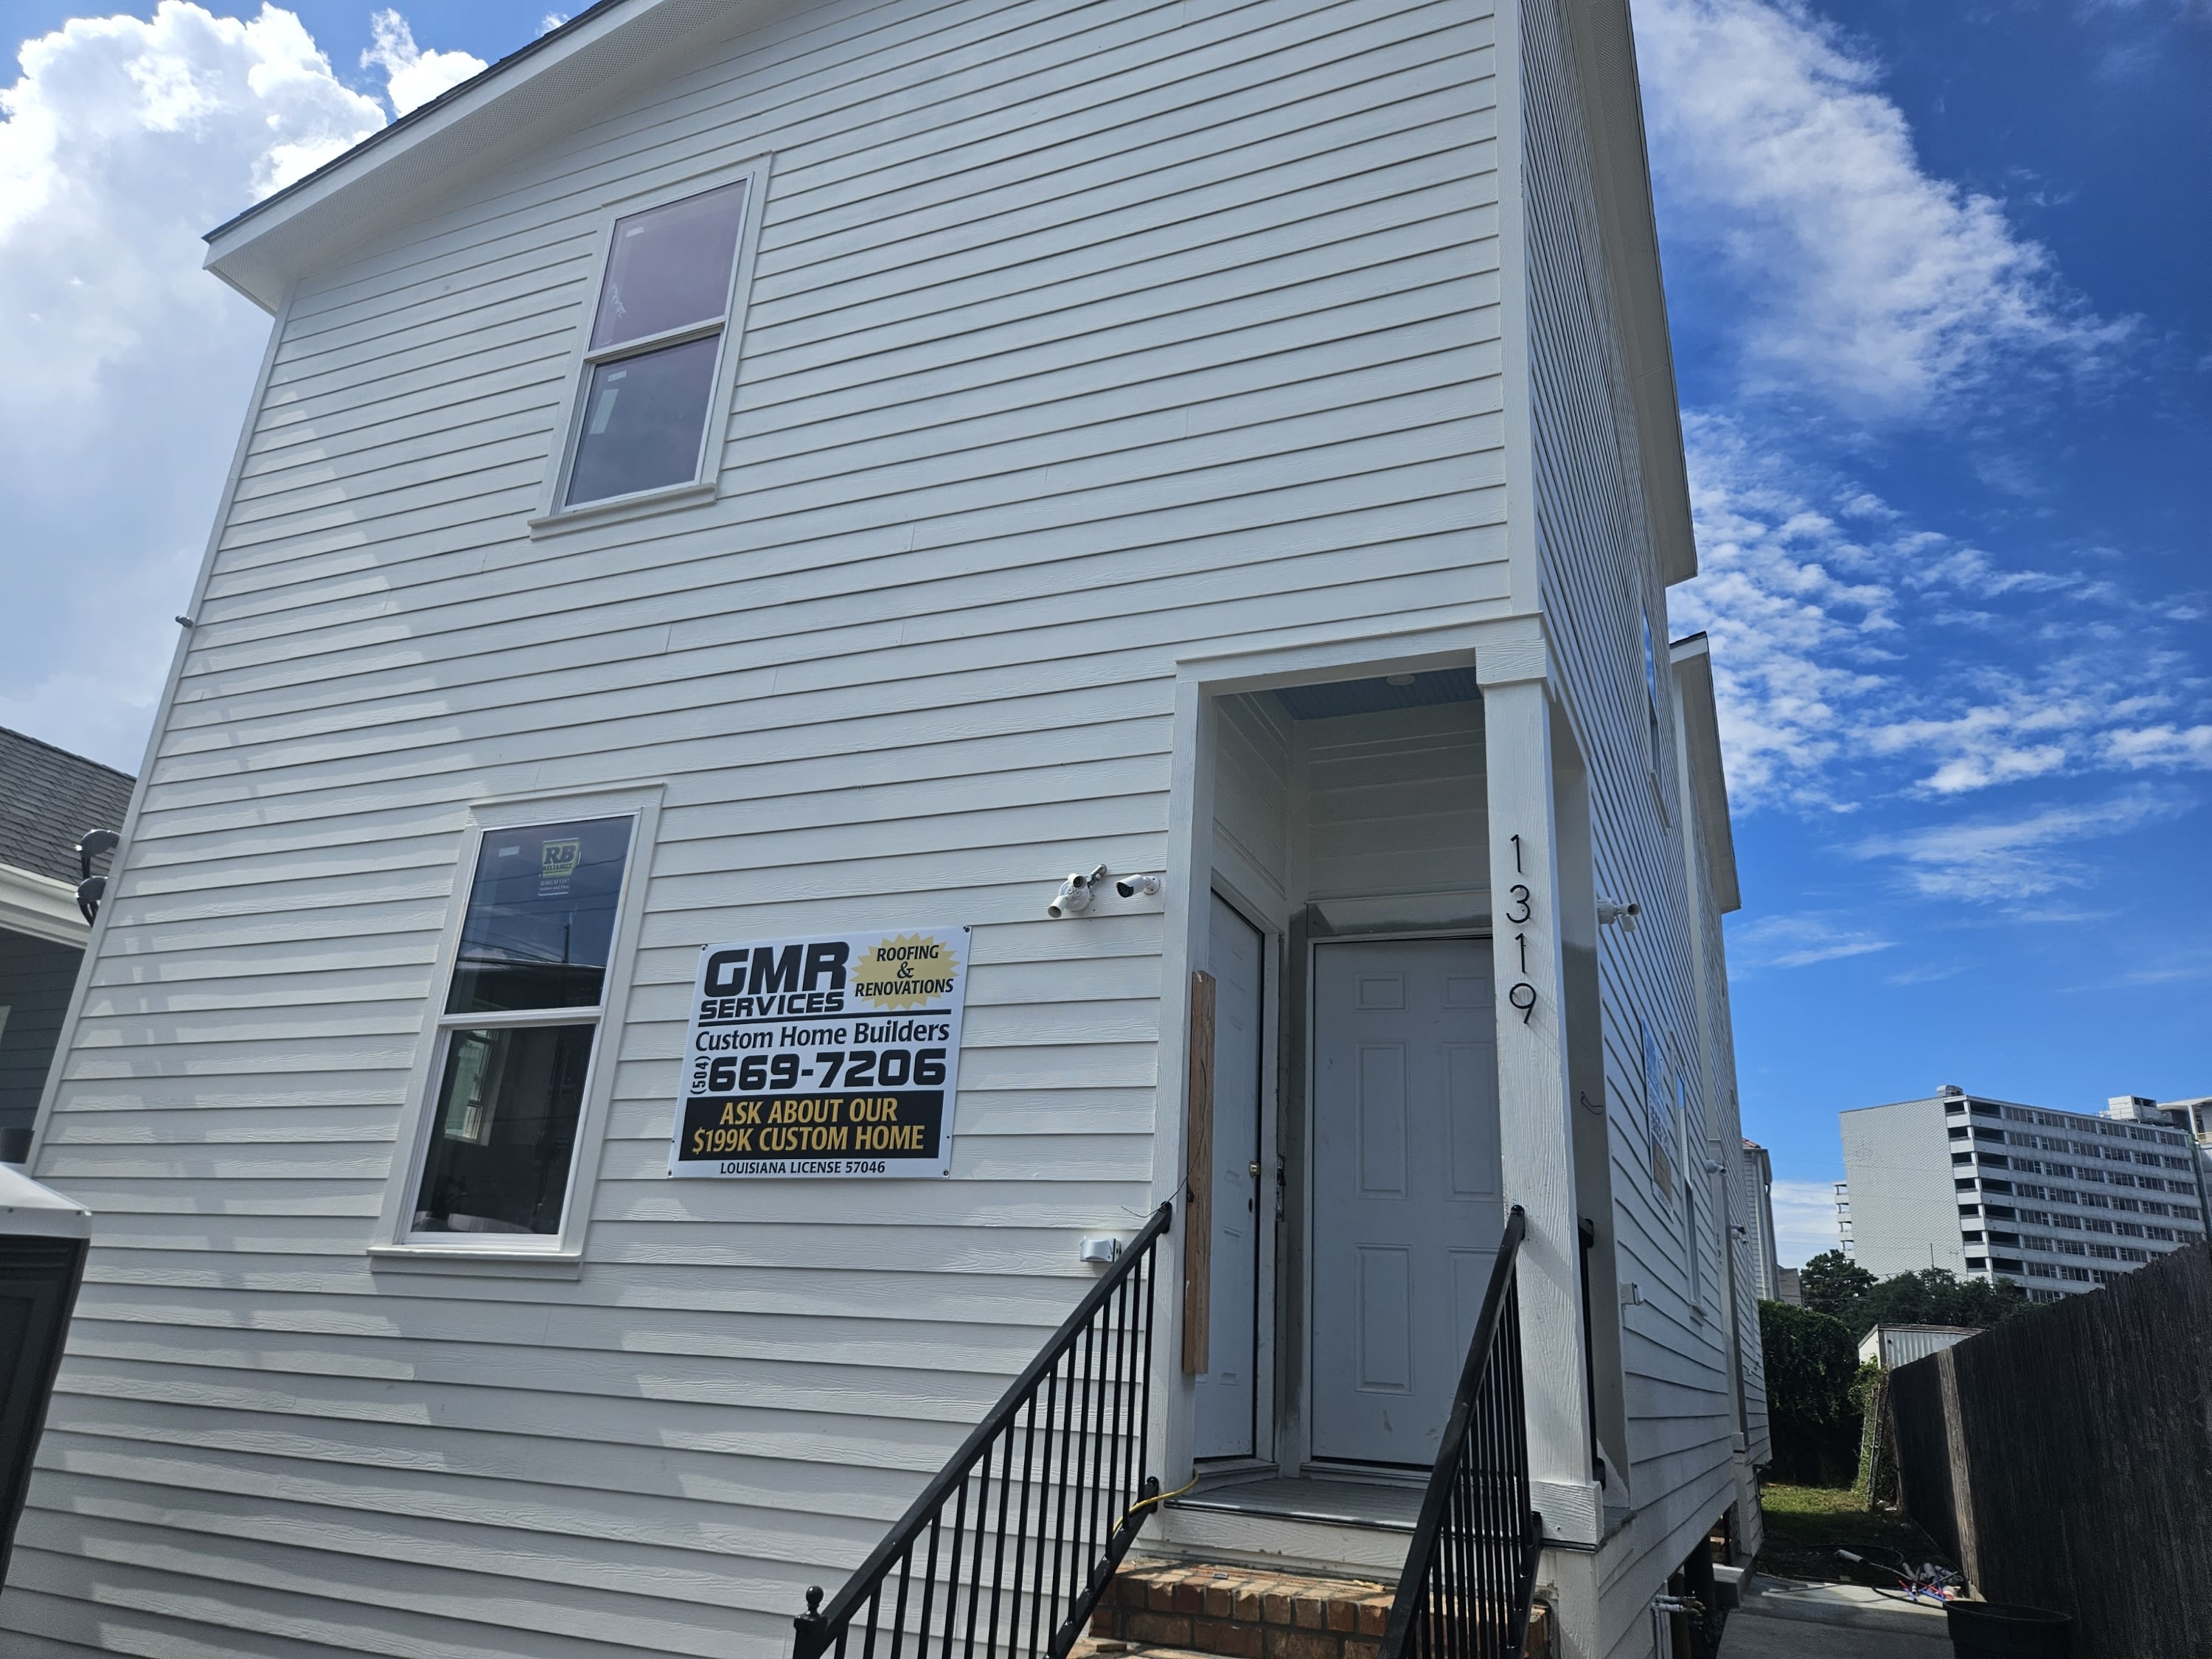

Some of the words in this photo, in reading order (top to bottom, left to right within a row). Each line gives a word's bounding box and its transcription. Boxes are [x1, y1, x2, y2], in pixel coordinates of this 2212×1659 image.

[543, 846, 576, 864] RB
[1506, 834, 1537, 1024] 1319
[877, 945, 939, 962] ROOFING
[704, 942, 849, 998] GMR
[897, 961, 914, 978] &
[855, 978, 954, 997] RENOVATIONS
[699, 992, 844, 1020] SERVICES
[695, 1031, 773, 1051] Custom
[780, 1026, 846, 1047] Home
[854, 1020, 950, 1044] Builders
[690, 1056, 712, 1095] (504)
[709, 1048, 946, 1092] 669-7206
[720, 1102, 763, 1125] ASK
[768, 1099, 844, 1124] ABOUT
[849, 1097, 897, 1122] OUR
[692, 1127, 752, 1155] $199K
[759, 1125, 849, 1151] CUSTOM
[855, 1124, 925, 1150] HOME
[720, 1162, 786, 1174] LOUISIANA
[790, 1161, 841, 1173] LICENSE
[845, 1161, 886, 1174] 57046
